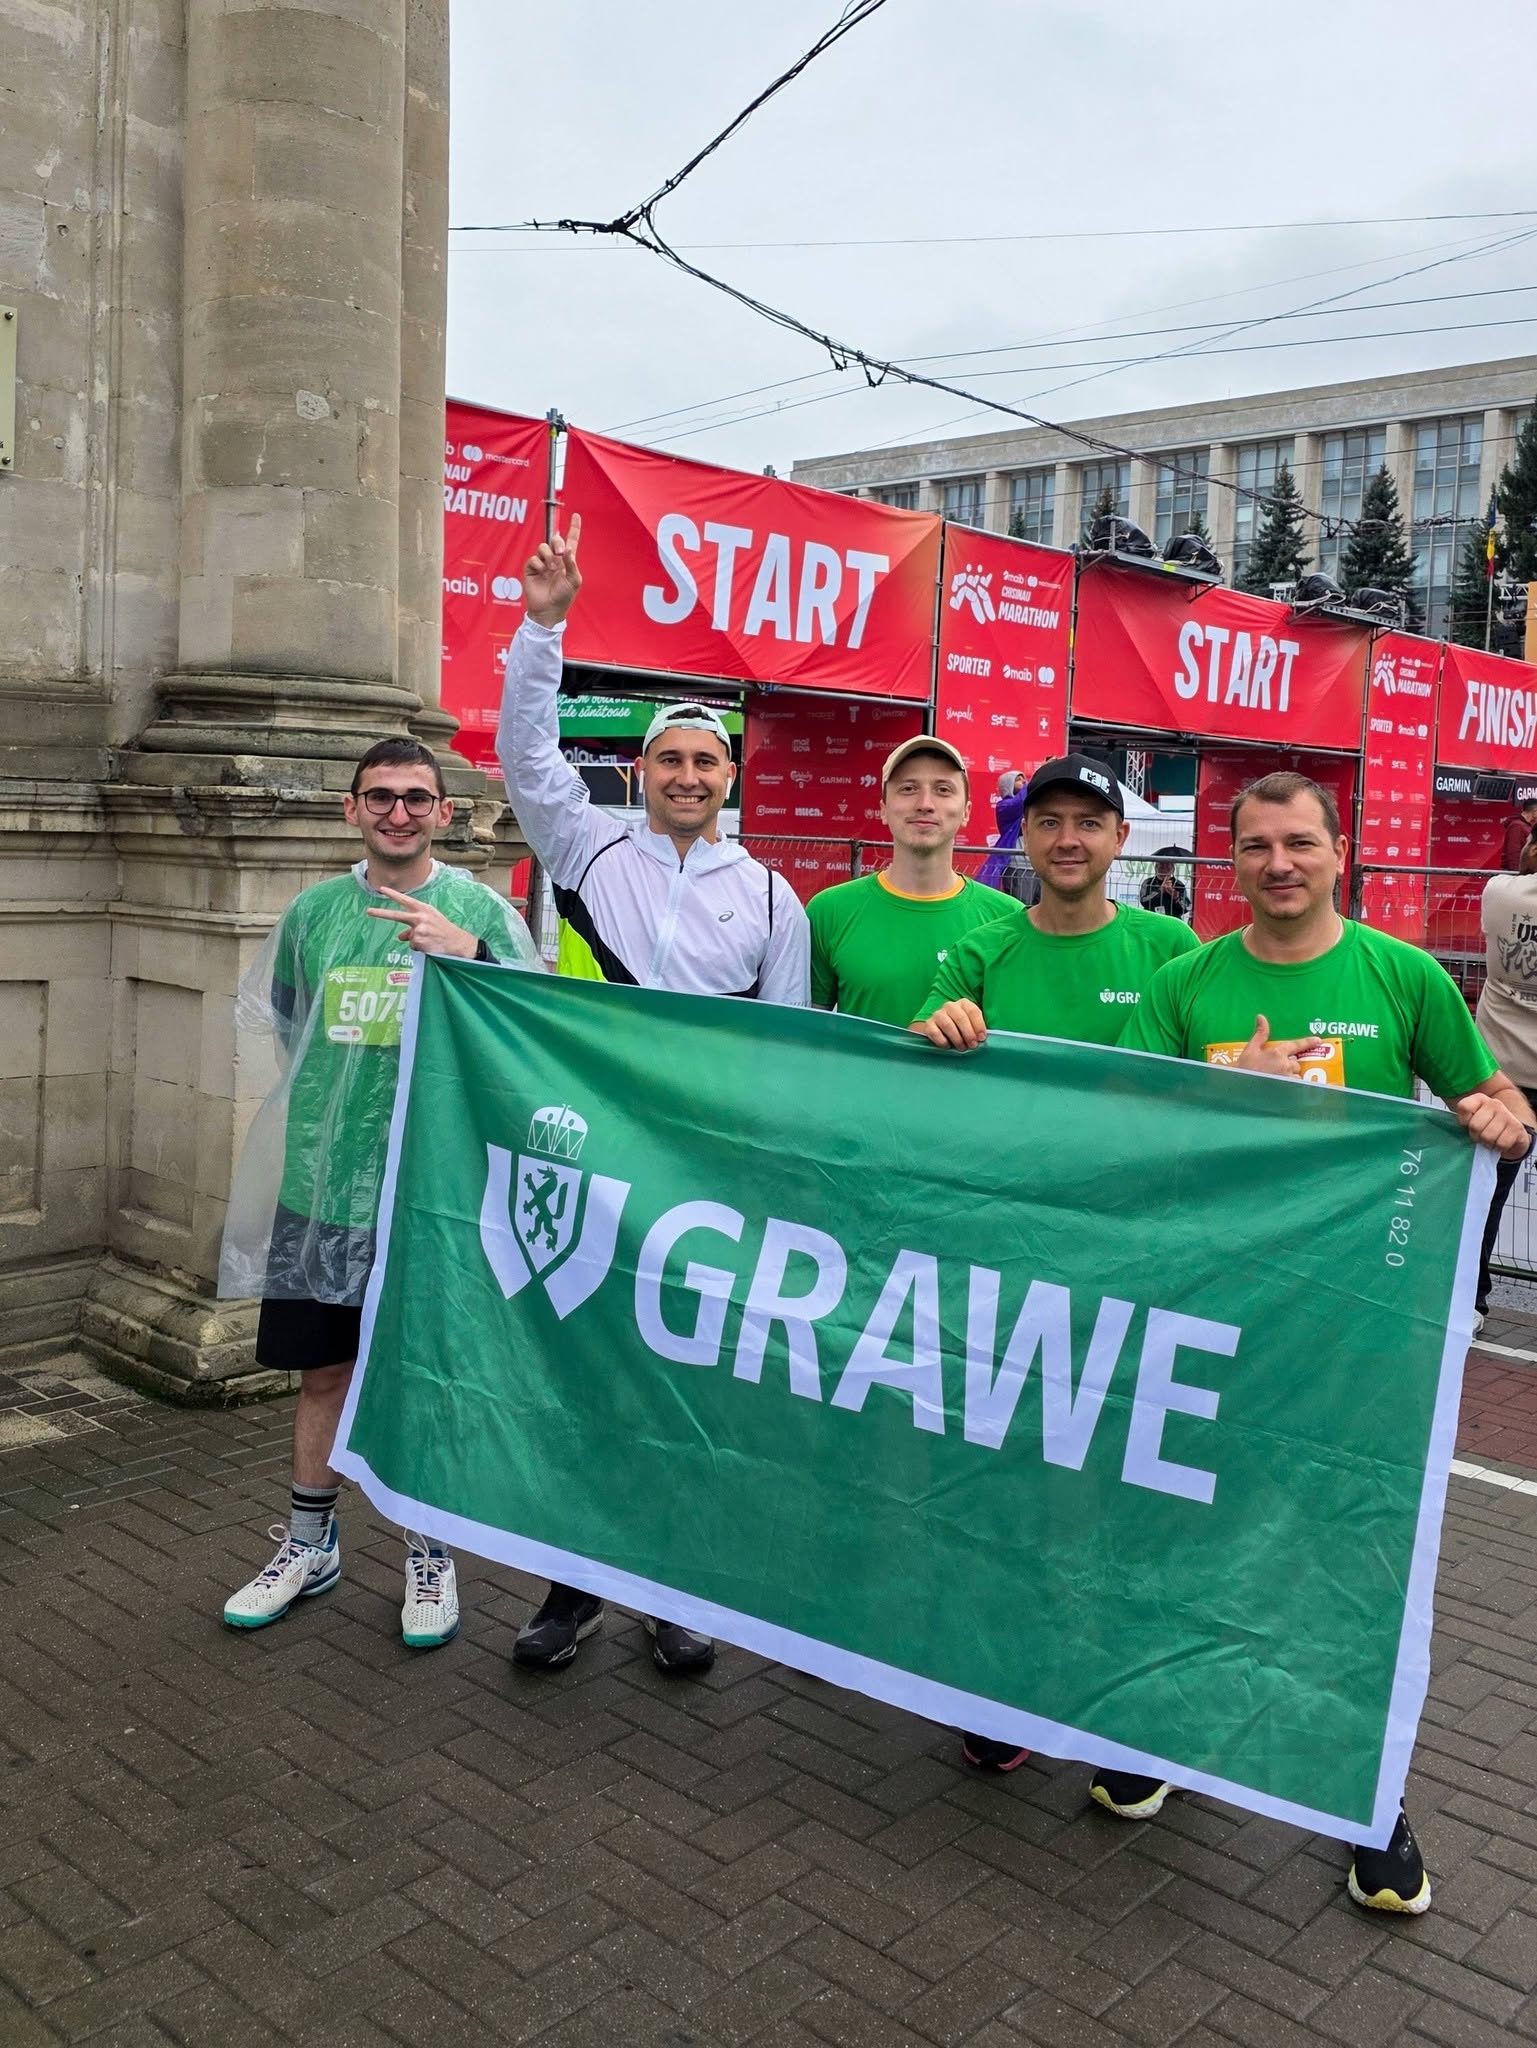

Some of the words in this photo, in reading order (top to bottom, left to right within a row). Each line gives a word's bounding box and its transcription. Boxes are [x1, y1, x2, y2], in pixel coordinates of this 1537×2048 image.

[485, 453, 530, 467] mastercard
[642, 513, 890, 650] START
[998, 601, 1059, 629] MARATHON
[946, 652, 991, 677] SPORTER
[1009, 667, 1033, 682] maib
[1174, 621, 1300, 713] START
[1397, 679, 1433, 698] MARATHON
[578, 704, 631, 717] sănătoase
[1458, 679, 1537, 749] FINISH
[819, 776, 852, 785] GARMIN
[1327, 1021, 1379, 1039] GRAWE
[1400, 1149, 1422, 1176] 76
[1394, 1185, 1416, 1207] 11
[634, 1200, 1242, 1505] GRAWE
